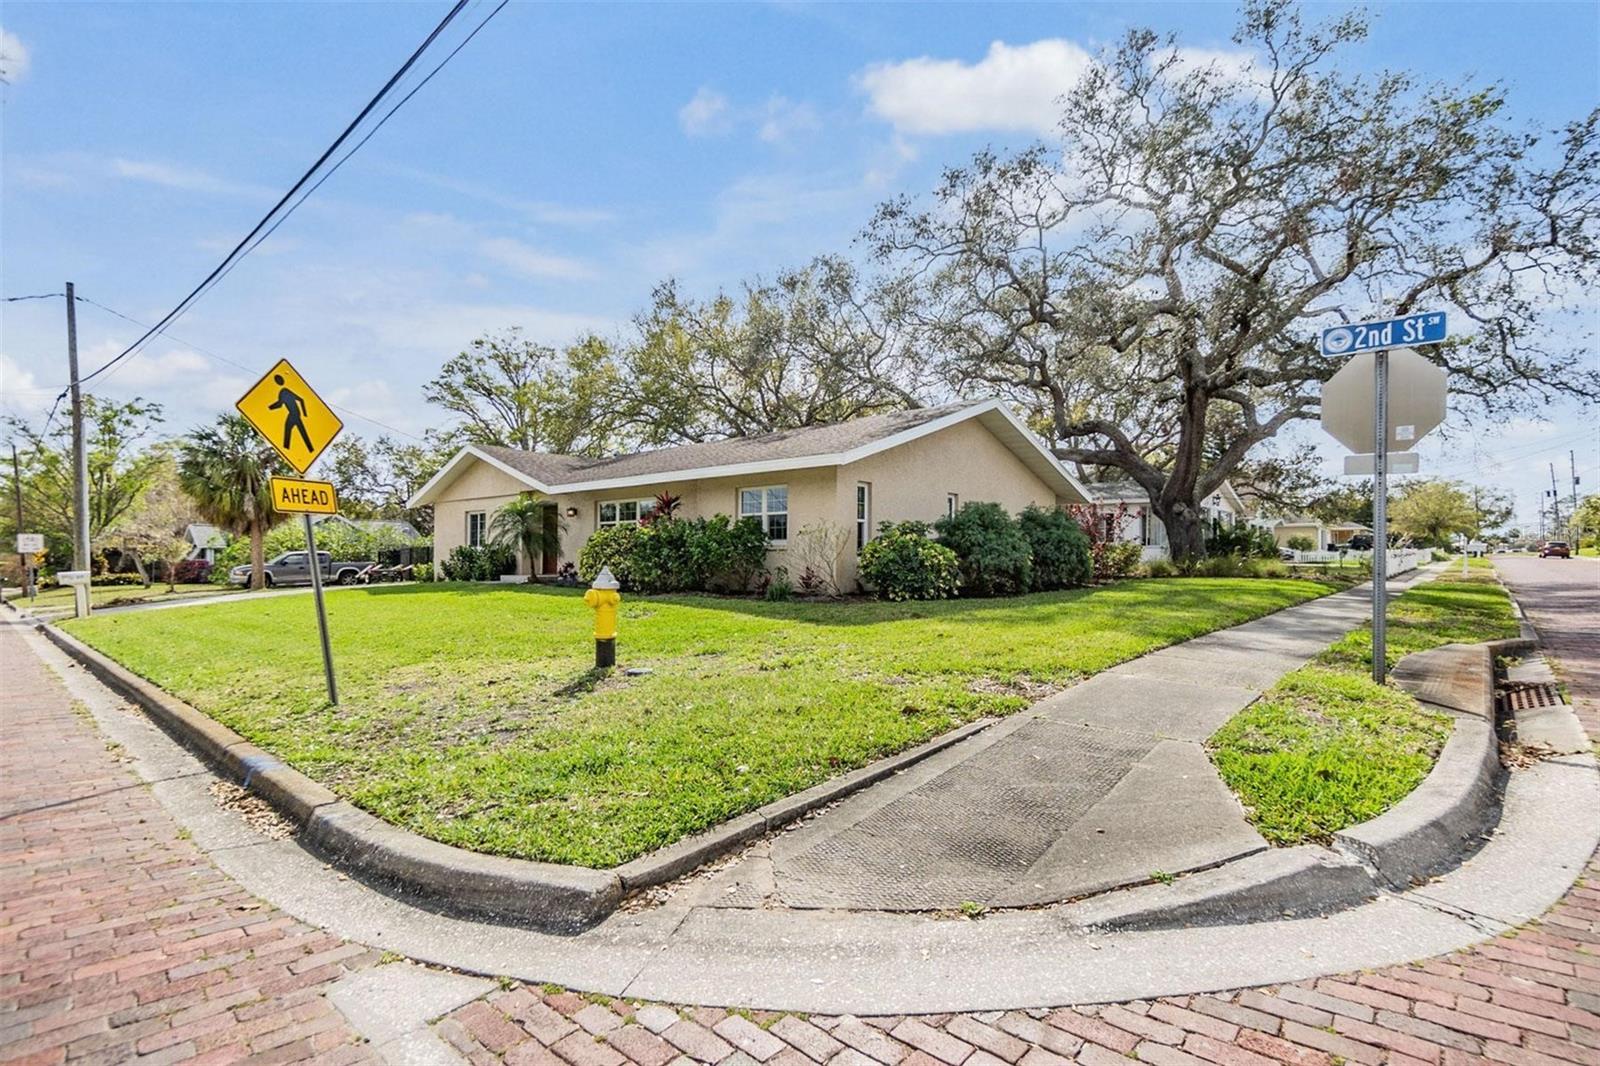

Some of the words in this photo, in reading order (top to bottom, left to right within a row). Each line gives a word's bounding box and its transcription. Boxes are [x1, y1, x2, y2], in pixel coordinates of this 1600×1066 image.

[1355, 322, 1392, 348] 2nd
[1403, 319, 1425, 342] St
[1428, 315, 1441, 325] SW
[282, 487, 329, 505] AHEAD
